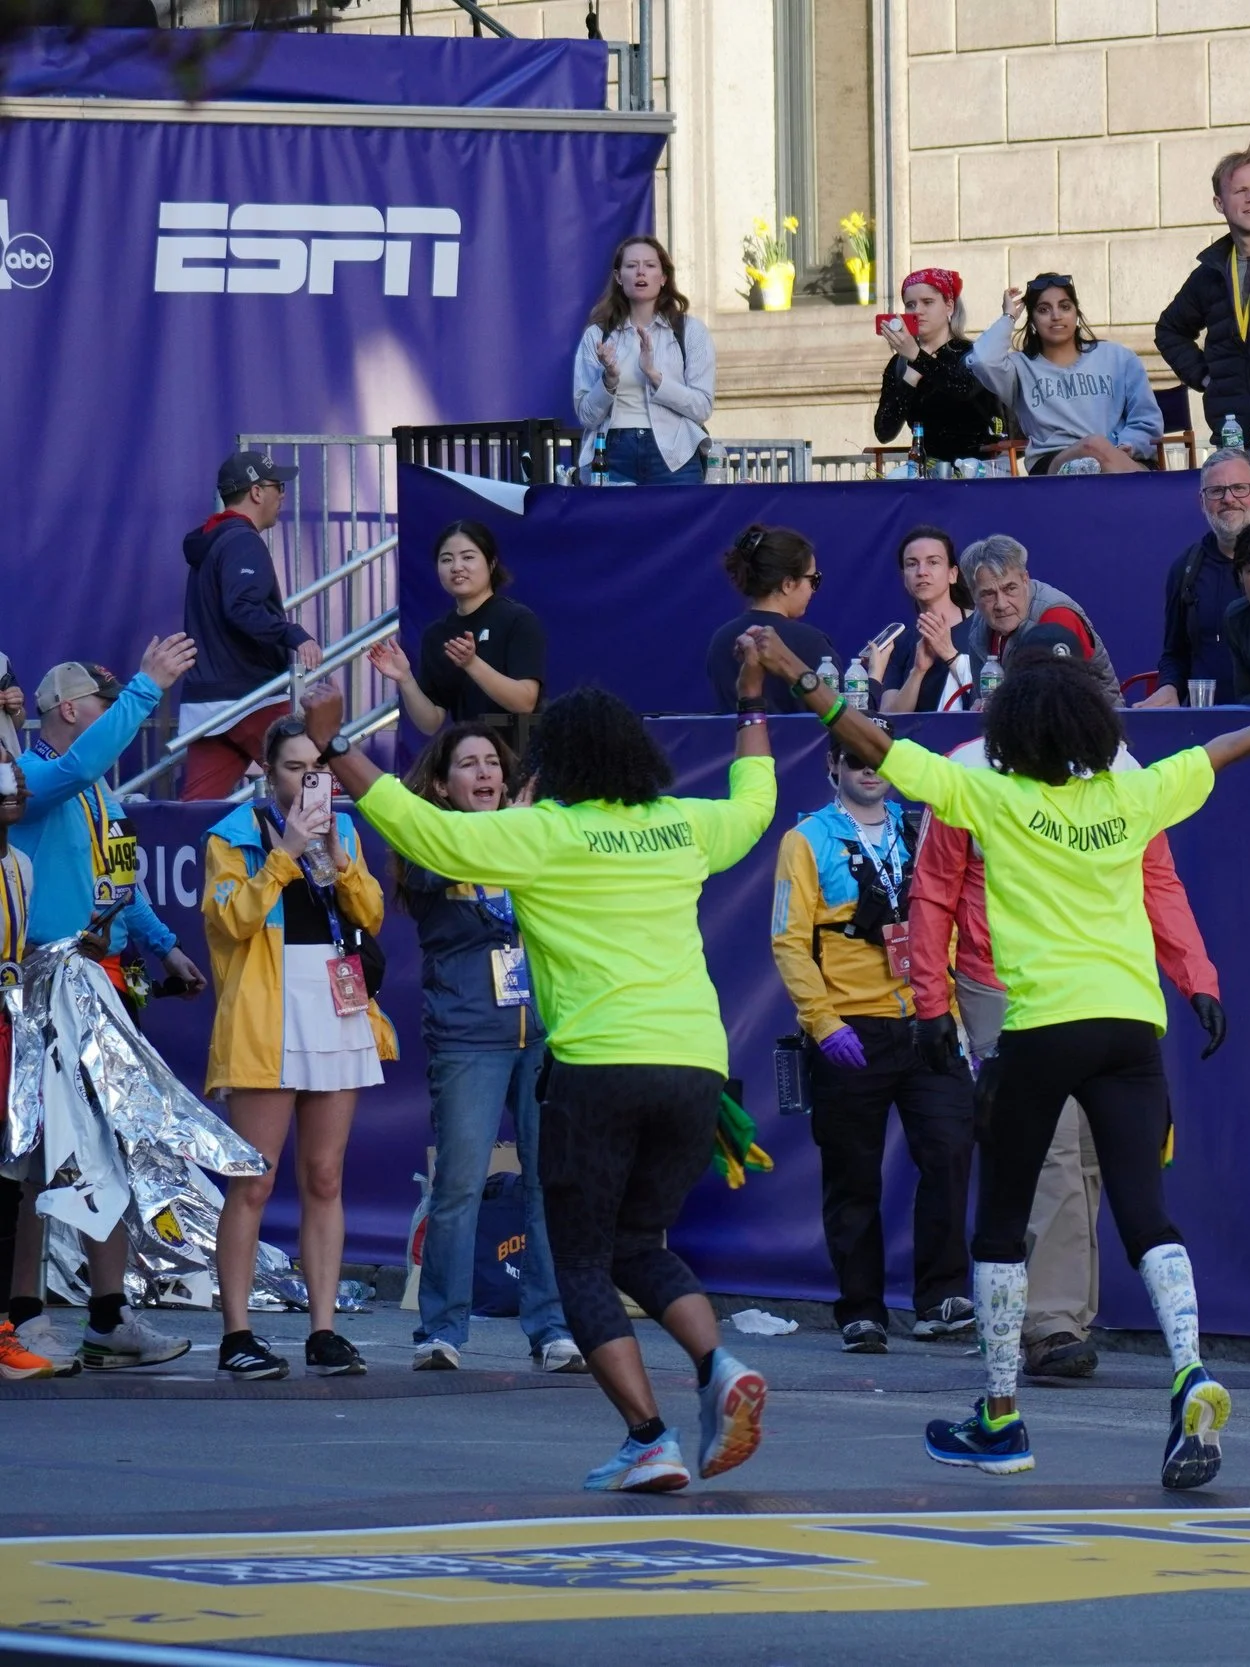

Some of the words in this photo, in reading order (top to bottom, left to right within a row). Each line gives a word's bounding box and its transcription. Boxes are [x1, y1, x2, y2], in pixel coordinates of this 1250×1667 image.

[5, 248, 52, 270] abc
[154, 202, 462, 297] ESPN
[583, 830, 631, 853] RUM
[1068, 816, 1129, 852] RUNNER
